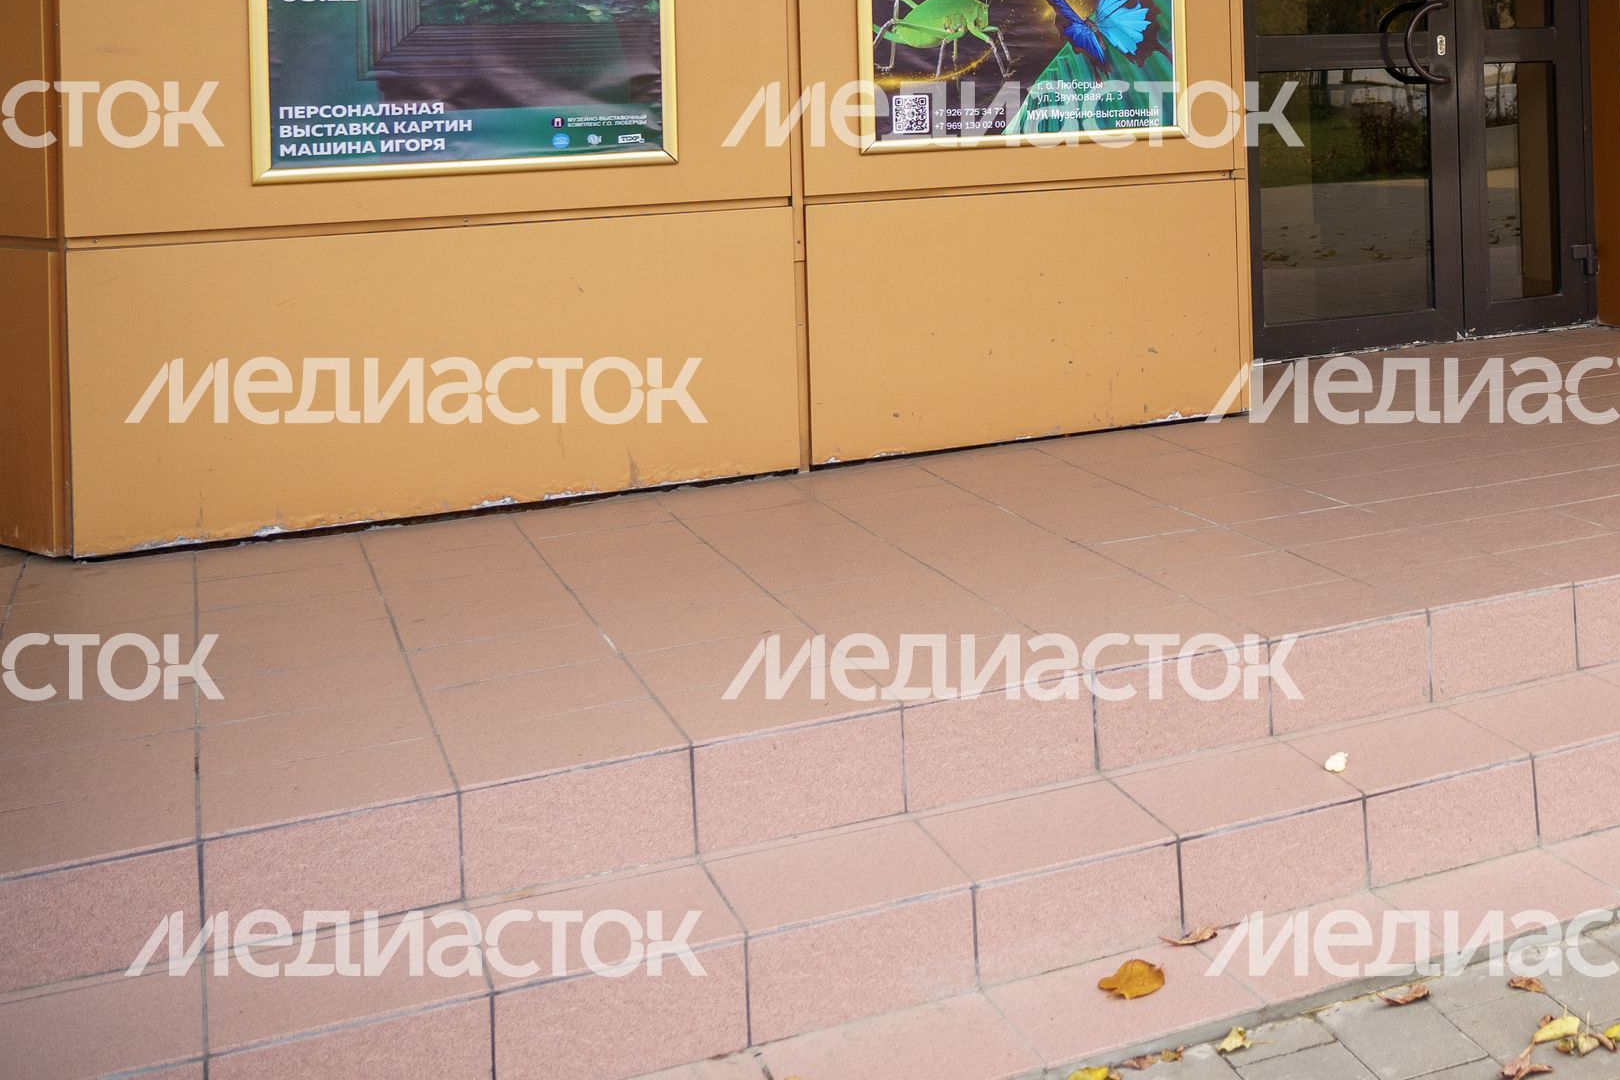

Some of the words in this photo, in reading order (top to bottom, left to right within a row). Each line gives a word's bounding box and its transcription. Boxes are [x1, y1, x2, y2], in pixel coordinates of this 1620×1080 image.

[1056, 80, 1103, 91] Люберцы
[1037, 94, 1051, 104] ул.
[1055, 92, 1104, 102] Звуковая,
[1106, 92, 1115, 101] д.
[1117, 91, 1123, 100] 3
[279, 102, 444, 120] ПЕРСОНАЛЬНАЯ
[934, 109, 944, 118] +7
[946, 108, 962, 118] 926
[964, 108, 979, 117] 725
[994, 107, 1005, 115] 72
[1026, 110, 1049, 120] МУК
[1051, 106, 1159, 119] Музейно-выставочный
[279, 121, 391, 139] ВЫСТАВКА
[394, 119, 473, 133] КАРТИН
[934, 123, 944, 131] +7
[946, 122, 962, 130] 969
[982, 121, 993, 129] 02
[995, 120, 1006, 129] 00
[1115, 118, 1160, 128] комплекс
[279, 141, 376, 158] МАШИНА
[380, 137, 446, 153] ИГОРЯ
